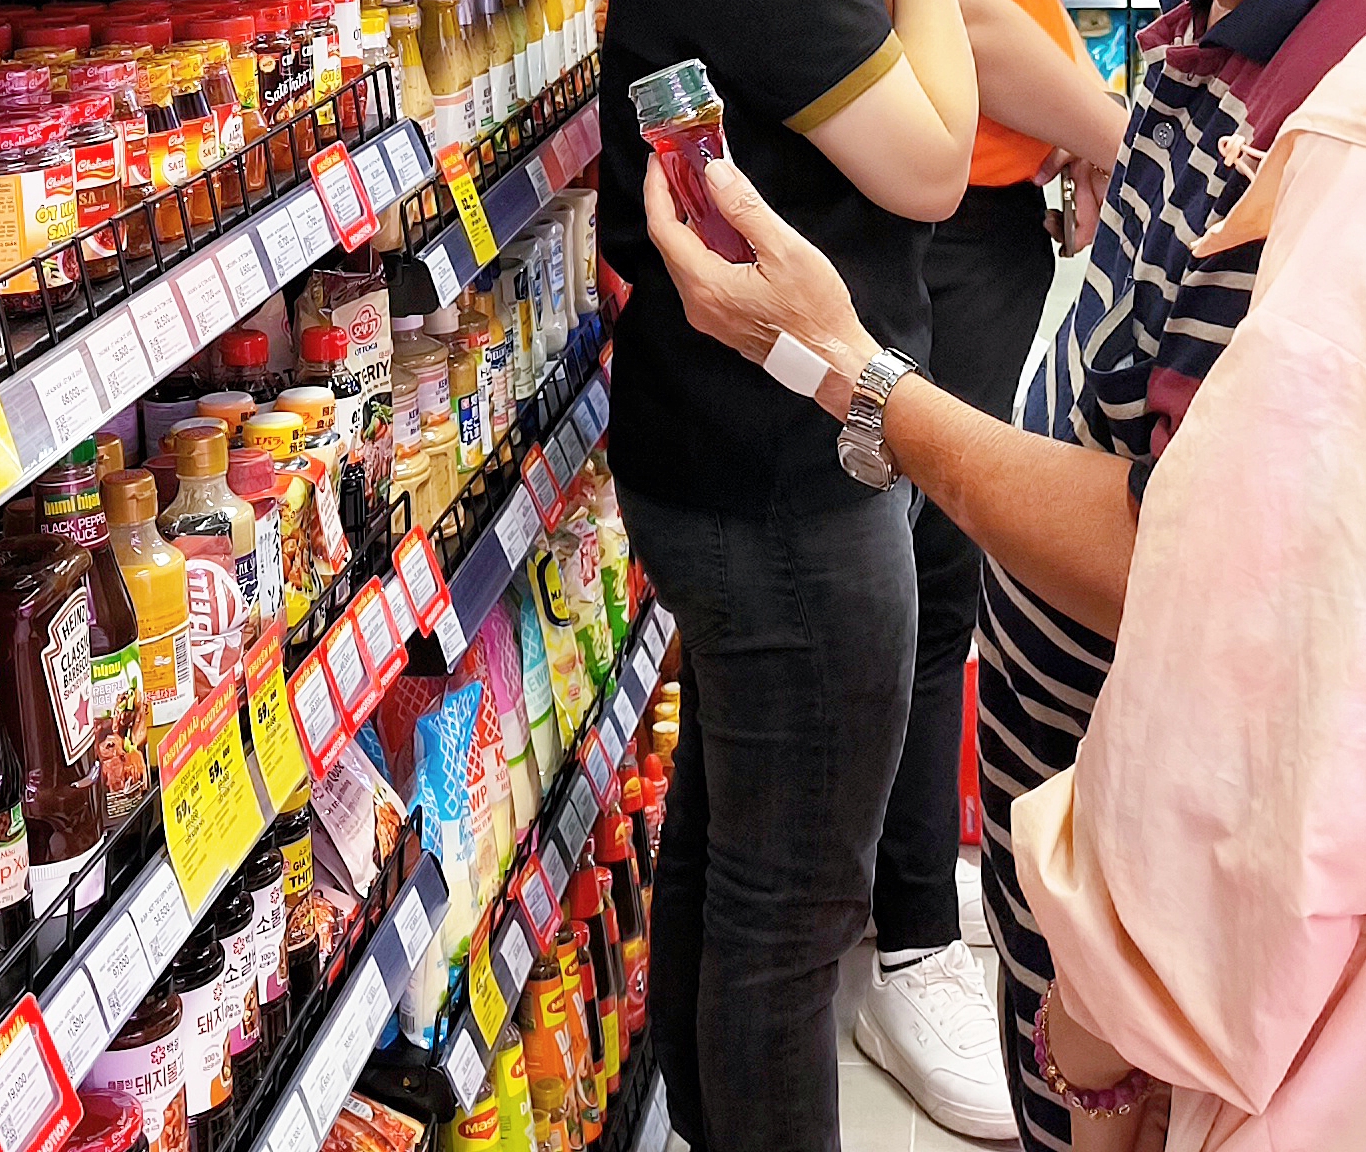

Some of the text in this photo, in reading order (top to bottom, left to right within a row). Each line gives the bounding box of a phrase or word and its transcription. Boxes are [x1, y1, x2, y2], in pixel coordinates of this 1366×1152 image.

[40, 520, 75, 536] BLACK
[62, 597, 88, 639] HEINZ
[91, 659, 122, 679] hijau
